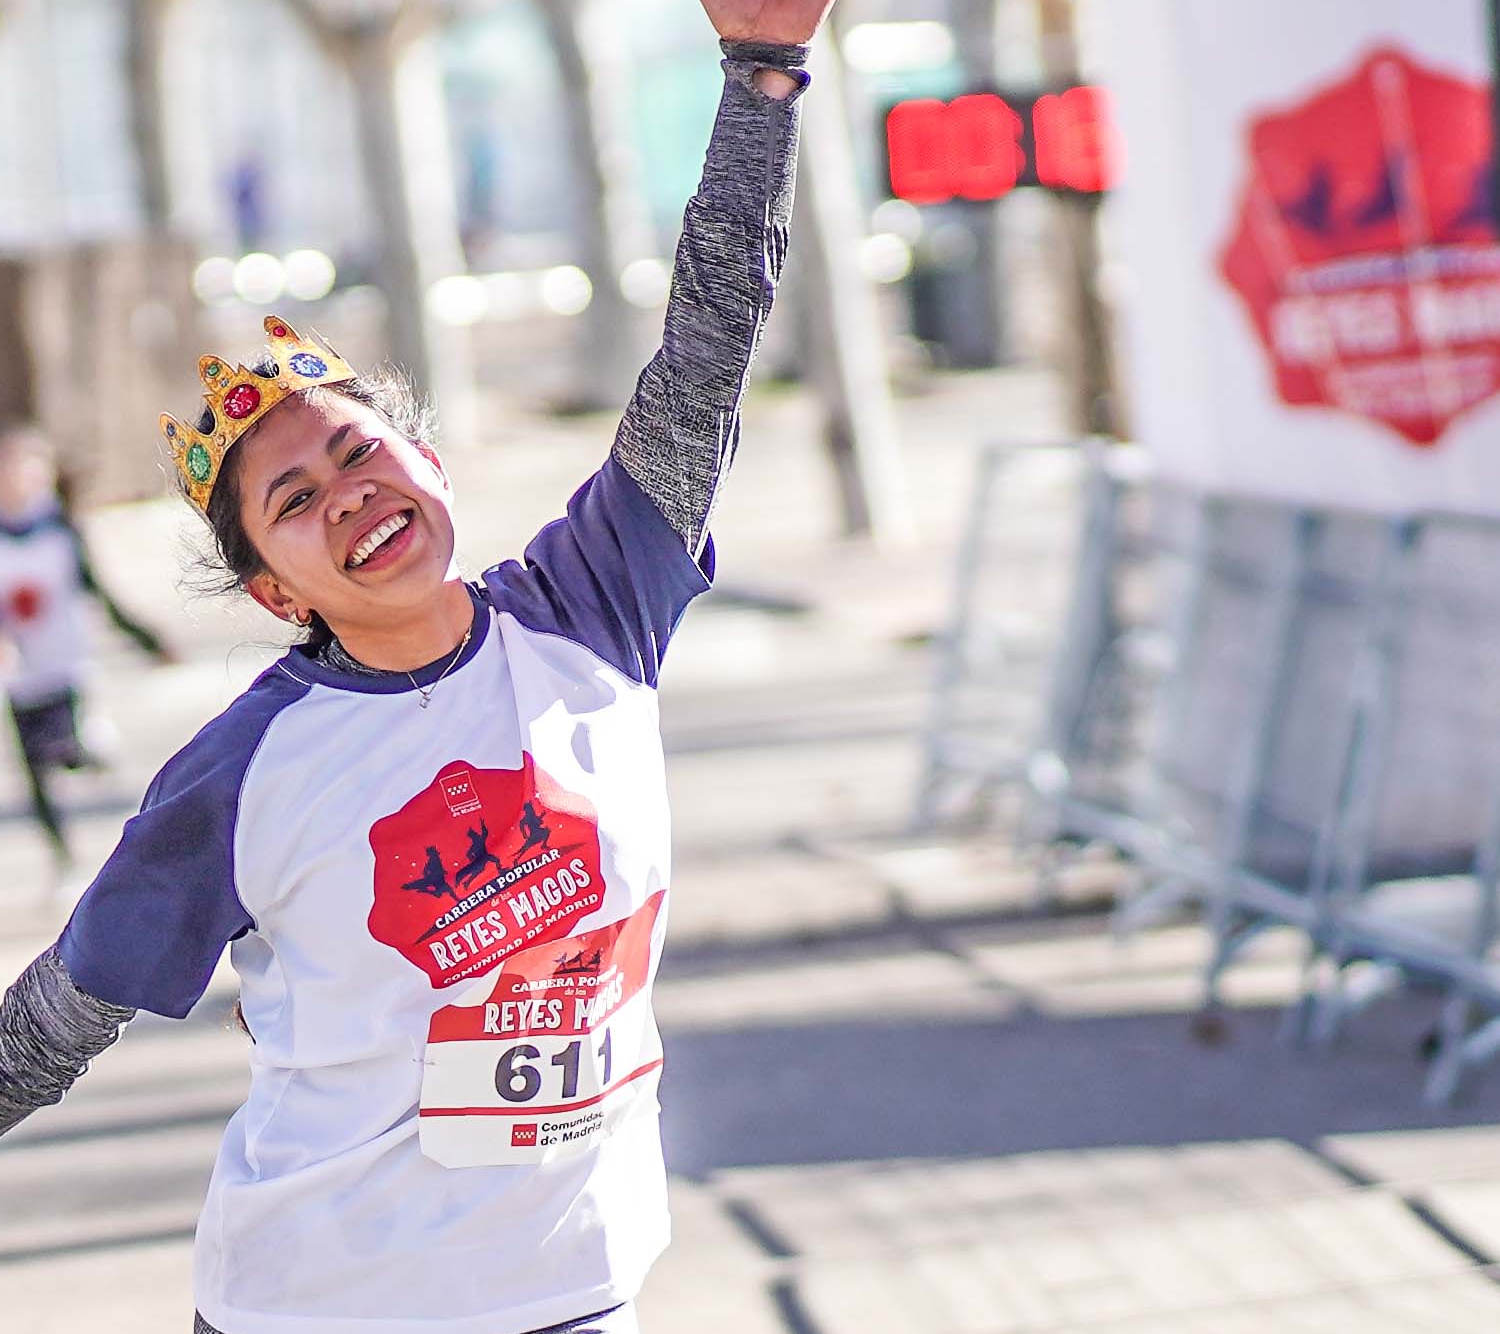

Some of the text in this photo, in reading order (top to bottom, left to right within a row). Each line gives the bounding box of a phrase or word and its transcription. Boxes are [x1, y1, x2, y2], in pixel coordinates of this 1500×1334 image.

[429, 858, 591, 970] REYES MAGOS
[435, 848, 561, 929] CARRERA POPULAR
[444, 893, 599, 984] COMUNIDAD DE MADRID
[484, 999, 563, 1034] REYES
[512, 976, 574, 993] CARRERA
[495, 1027, 611, 1102] 611
[540, 1135, 557, 1146] de
